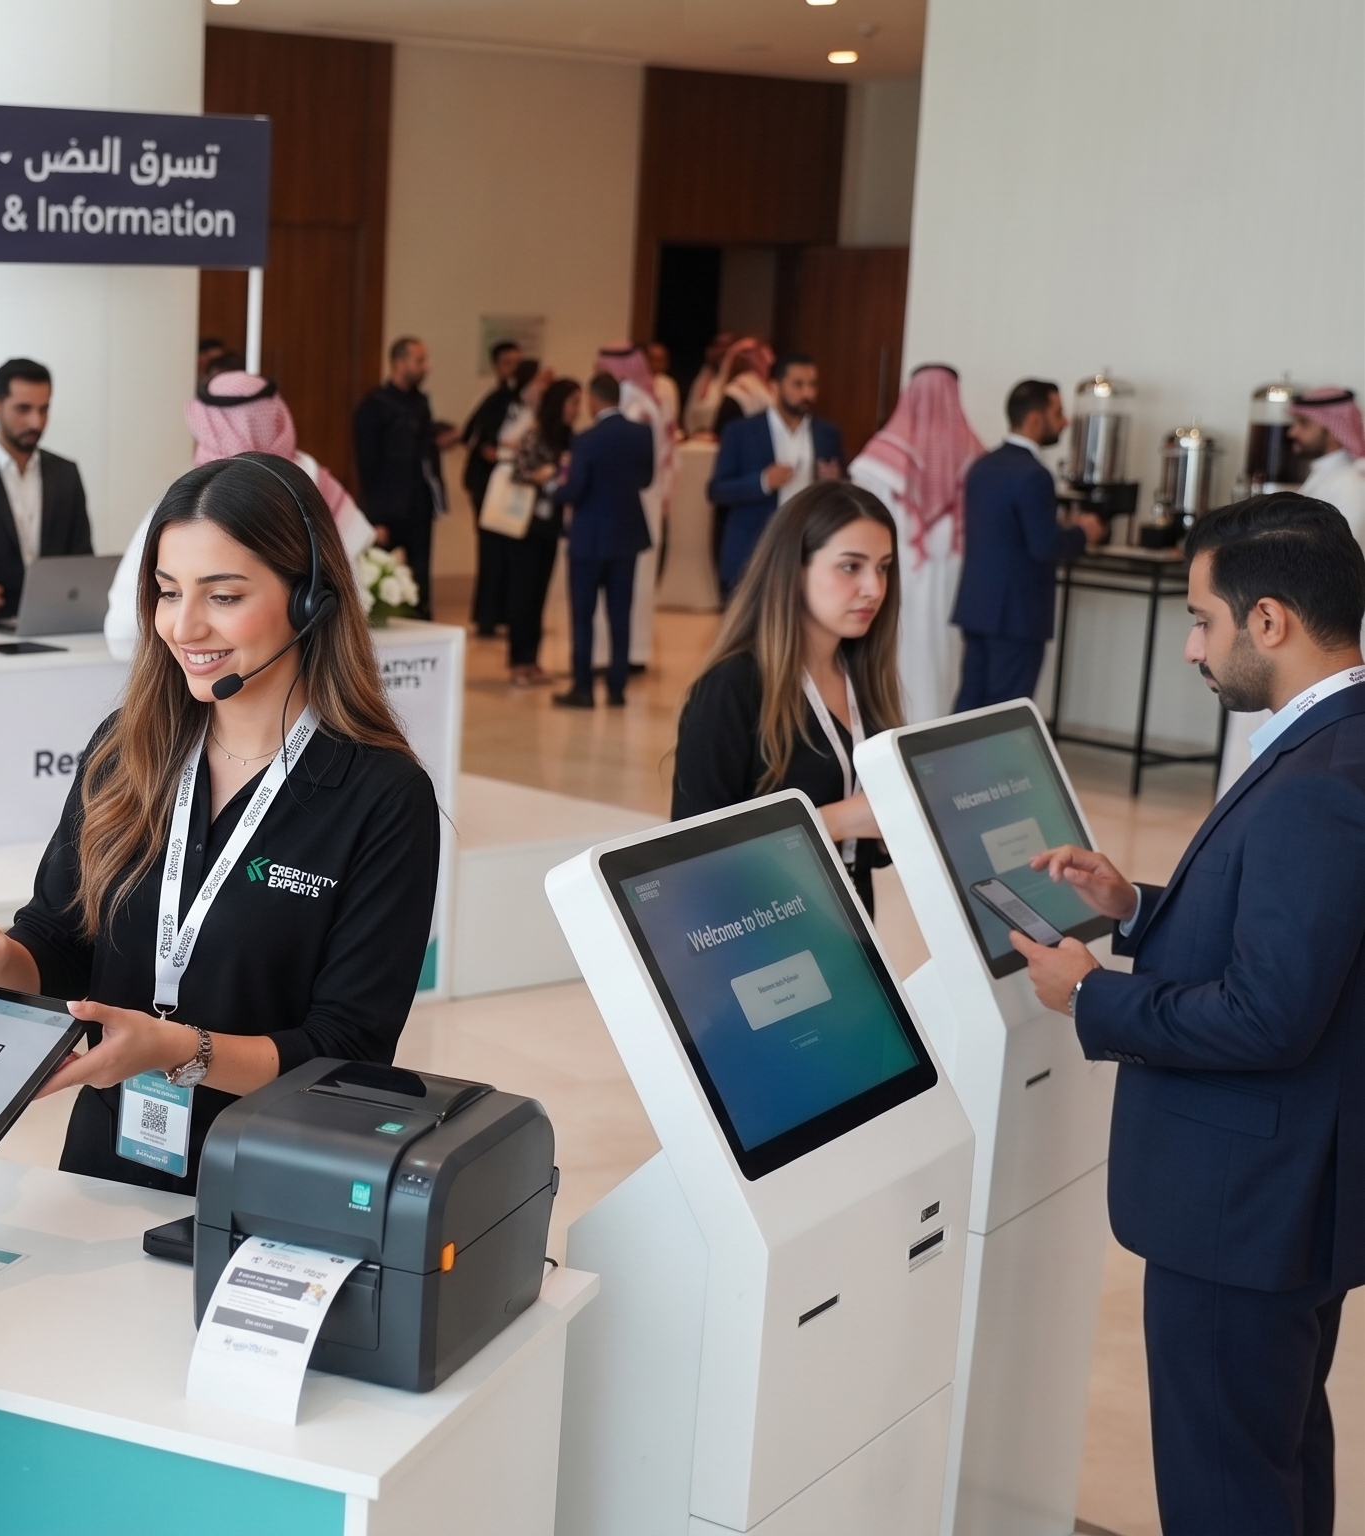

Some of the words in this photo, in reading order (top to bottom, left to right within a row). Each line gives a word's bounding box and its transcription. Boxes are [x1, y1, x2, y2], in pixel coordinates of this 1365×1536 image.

[2, 194, 27, 232] &
[37, 195, 236, 237] Information
[267, 875, 321, 899] EXPERTS
[687, 921, 743, 952] Welcome
[743, 916, 755, 932] to
[753, 908, 774, 928] the
[771, 896, 806, 920] Event
